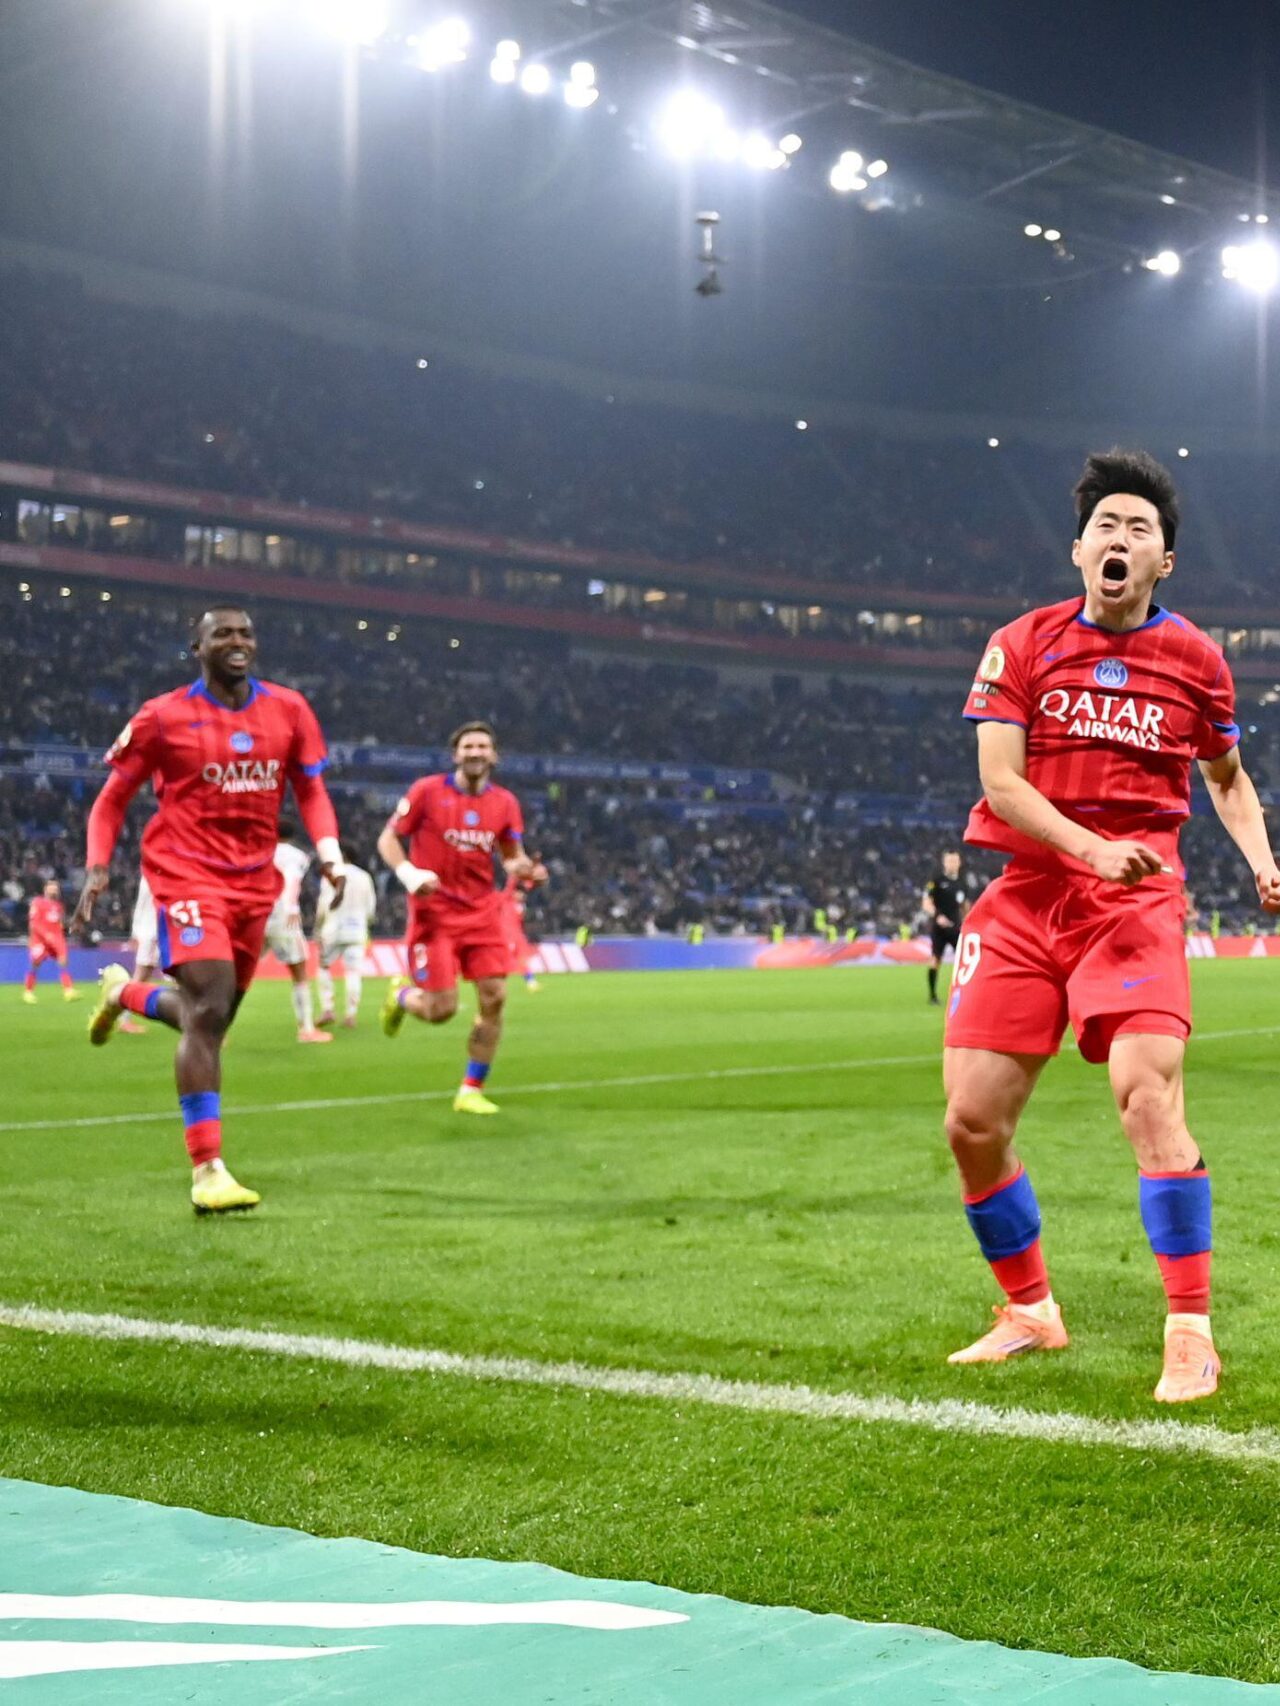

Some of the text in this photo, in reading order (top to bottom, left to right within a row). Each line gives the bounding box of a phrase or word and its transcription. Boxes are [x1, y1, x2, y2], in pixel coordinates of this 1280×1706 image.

[1039, 689, 1164, 735] QATAR
[1068, 719, 1161, 751] AIRWAYS
[203, 759, 281, 786] QATAR
[952, 932, 981, 986] 19
